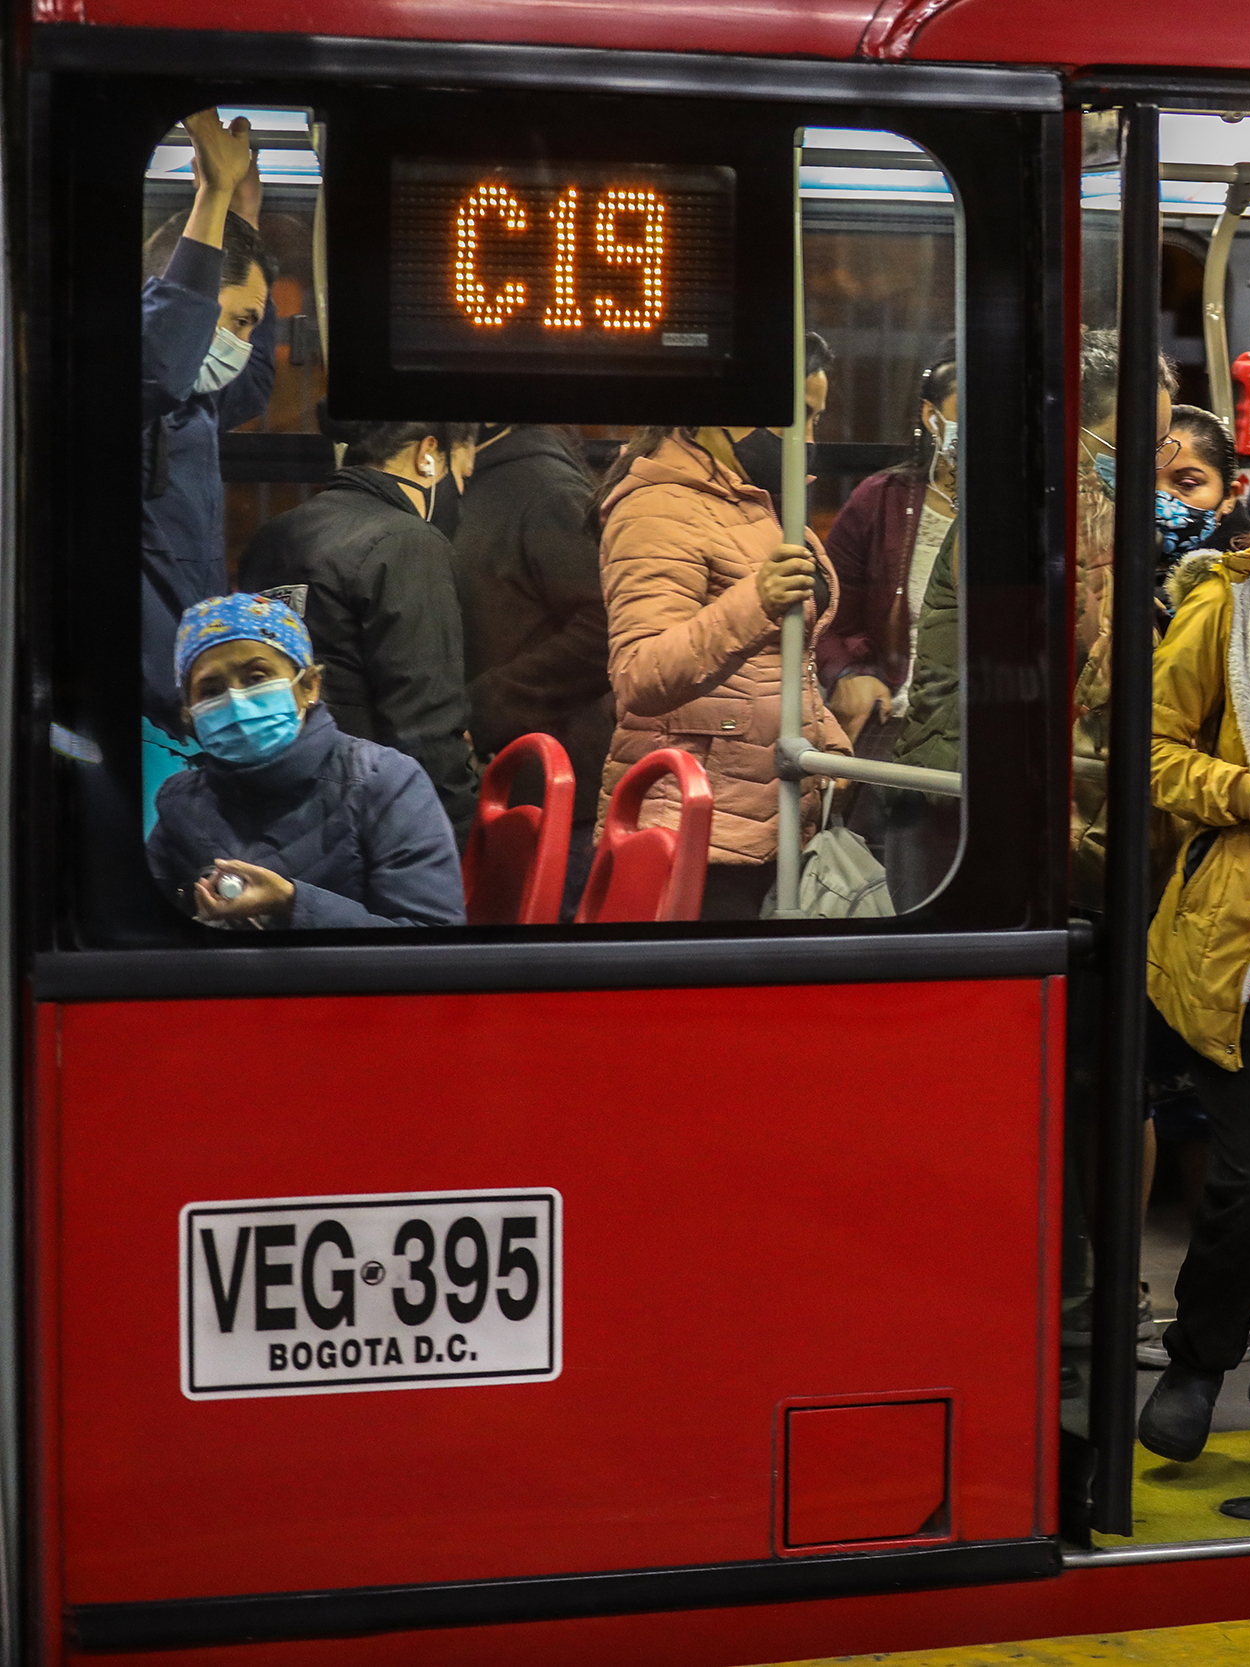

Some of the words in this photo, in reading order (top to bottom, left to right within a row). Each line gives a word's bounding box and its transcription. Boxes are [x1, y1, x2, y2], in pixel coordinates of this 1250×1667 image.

[453, 182, 667, 331] C19
[200, 1219, 356, 1333] VEG
[391, 1216, 540, 1326] 395
[268, 1336, 403, 1372] BOGOTA
[414, 1333, 478, 1364] D.C.
